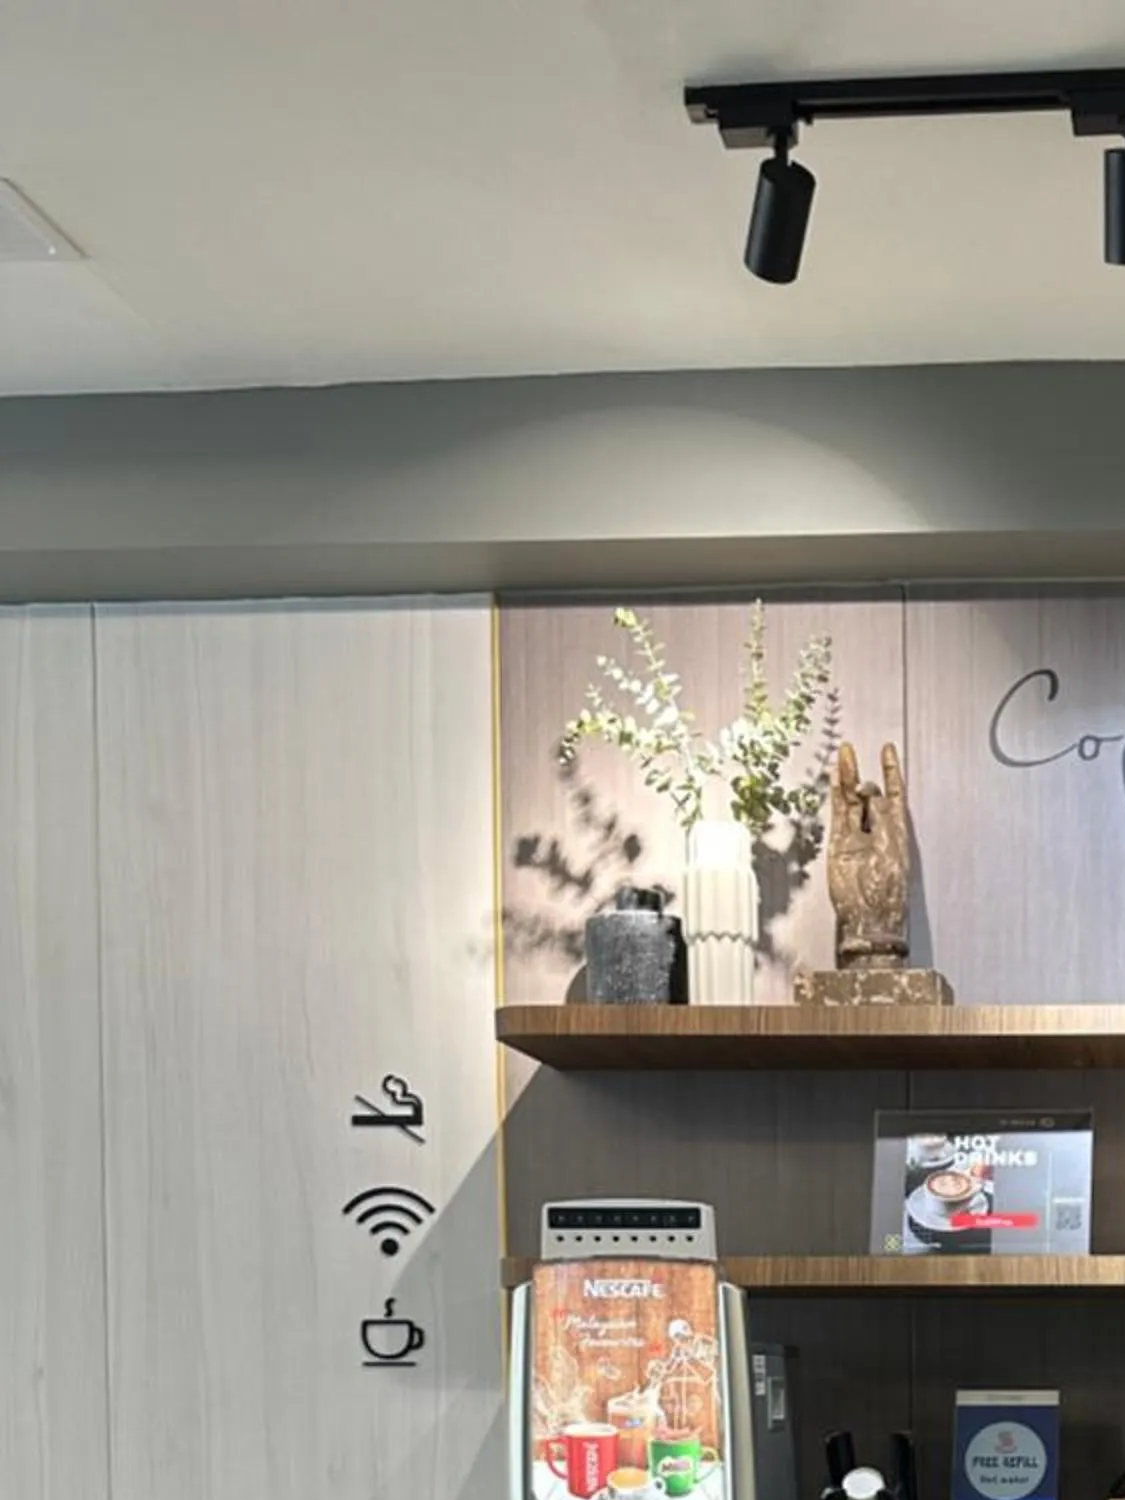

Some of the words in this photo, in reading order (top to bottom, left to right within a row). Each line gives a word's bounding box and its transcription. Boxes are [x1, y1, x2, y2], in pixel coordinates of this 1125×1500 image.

[953, 1135, 1000, 1151] HOT
[953, 1151, 1038, 1166] DRINKS
[972, 1456, 999, 1468] FREE
[1002, 1456, 1039, 1468] REFILL
